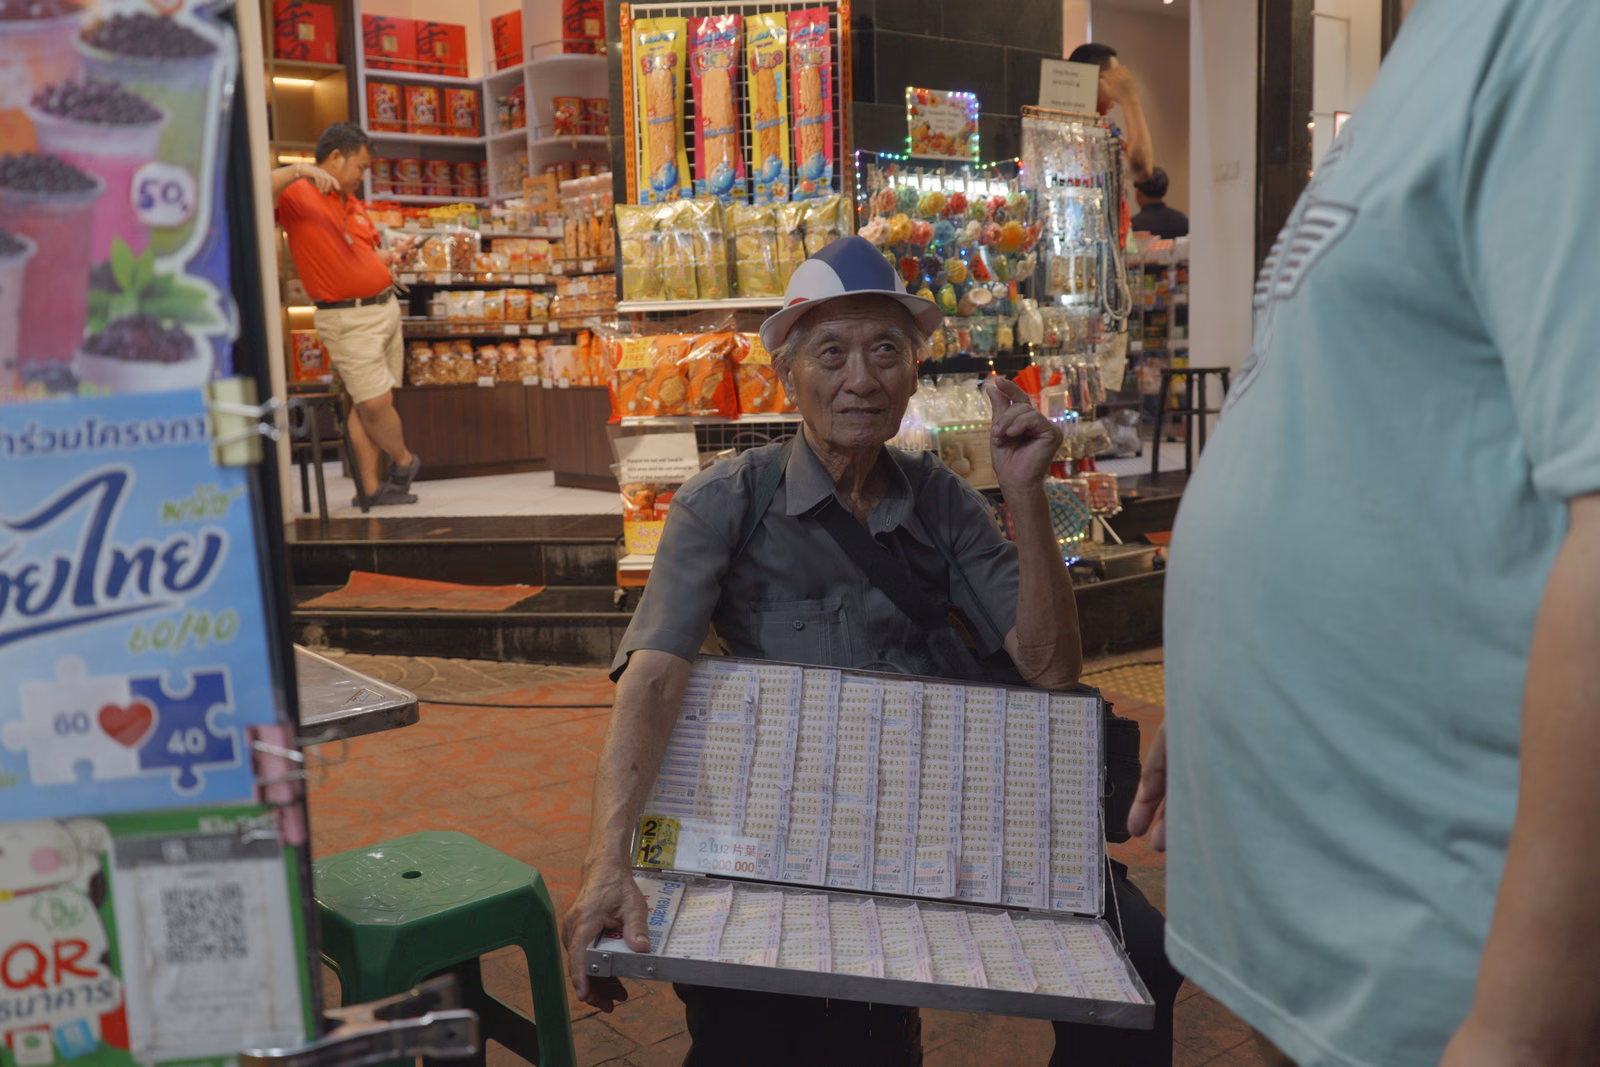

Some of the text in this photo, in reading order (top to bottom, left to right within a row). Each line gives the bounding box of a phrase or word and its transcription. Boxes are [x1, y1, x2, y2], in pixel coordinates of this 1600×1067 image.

[55, 712, 89, 736] 60
[168, 730, 205, 755] 40
[644, 820, 658, 837] 2
[658, 882, 681, 896] Buy
[649, 897, 671, 926] rewards
[0, 938, 98, 989] QR
